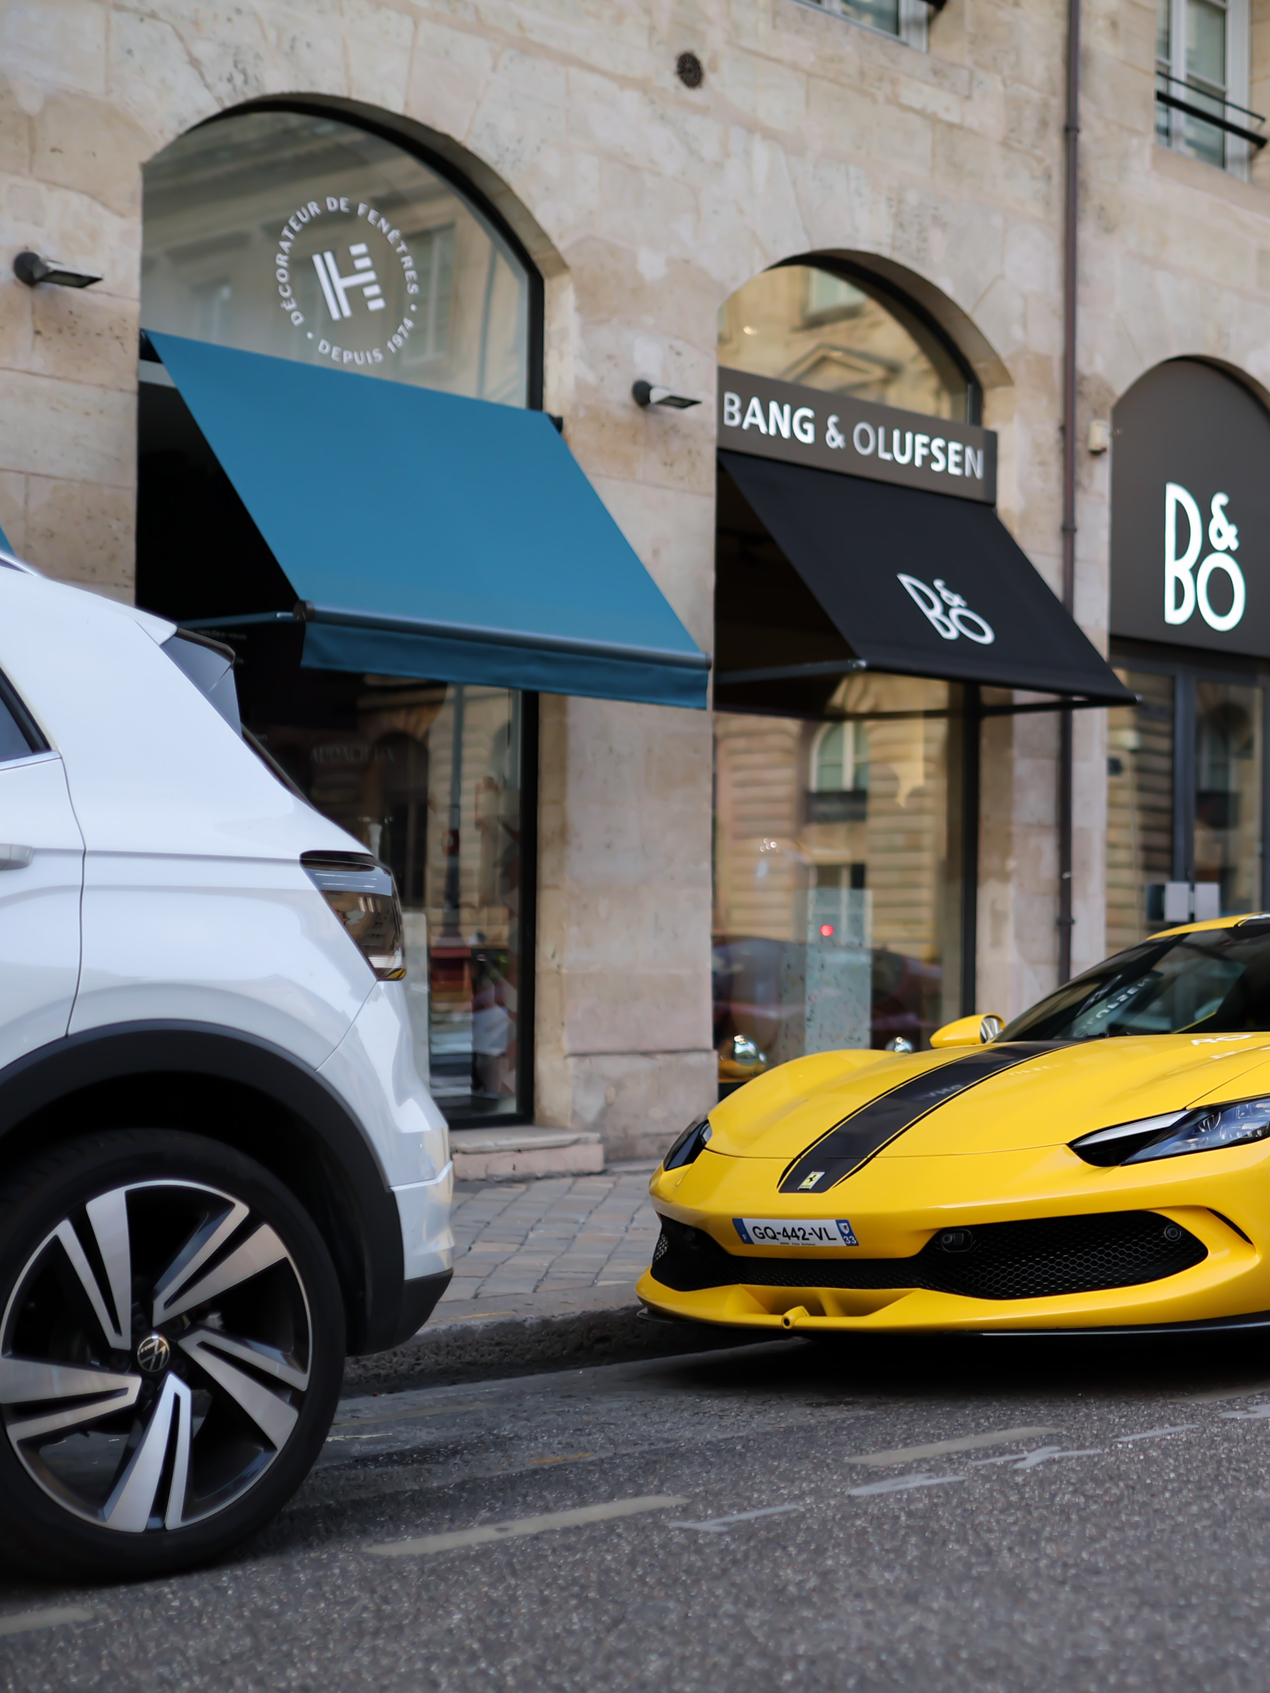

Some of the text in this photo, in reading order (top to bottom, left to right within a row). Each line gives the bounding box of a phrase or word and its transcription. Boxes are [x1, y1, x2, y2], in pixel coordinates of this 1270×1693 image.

[275, 196, 420, 326] DÉCORATEUR DE FENÊTRES
[318, 316, 415, 366] DEPUIS 1974
[723, 390, 984, 480] BANG & OLUFSEN
[752, 1225, 838, 1242] GQ-442-VL
[843, 1235, 858, 1245] 33
